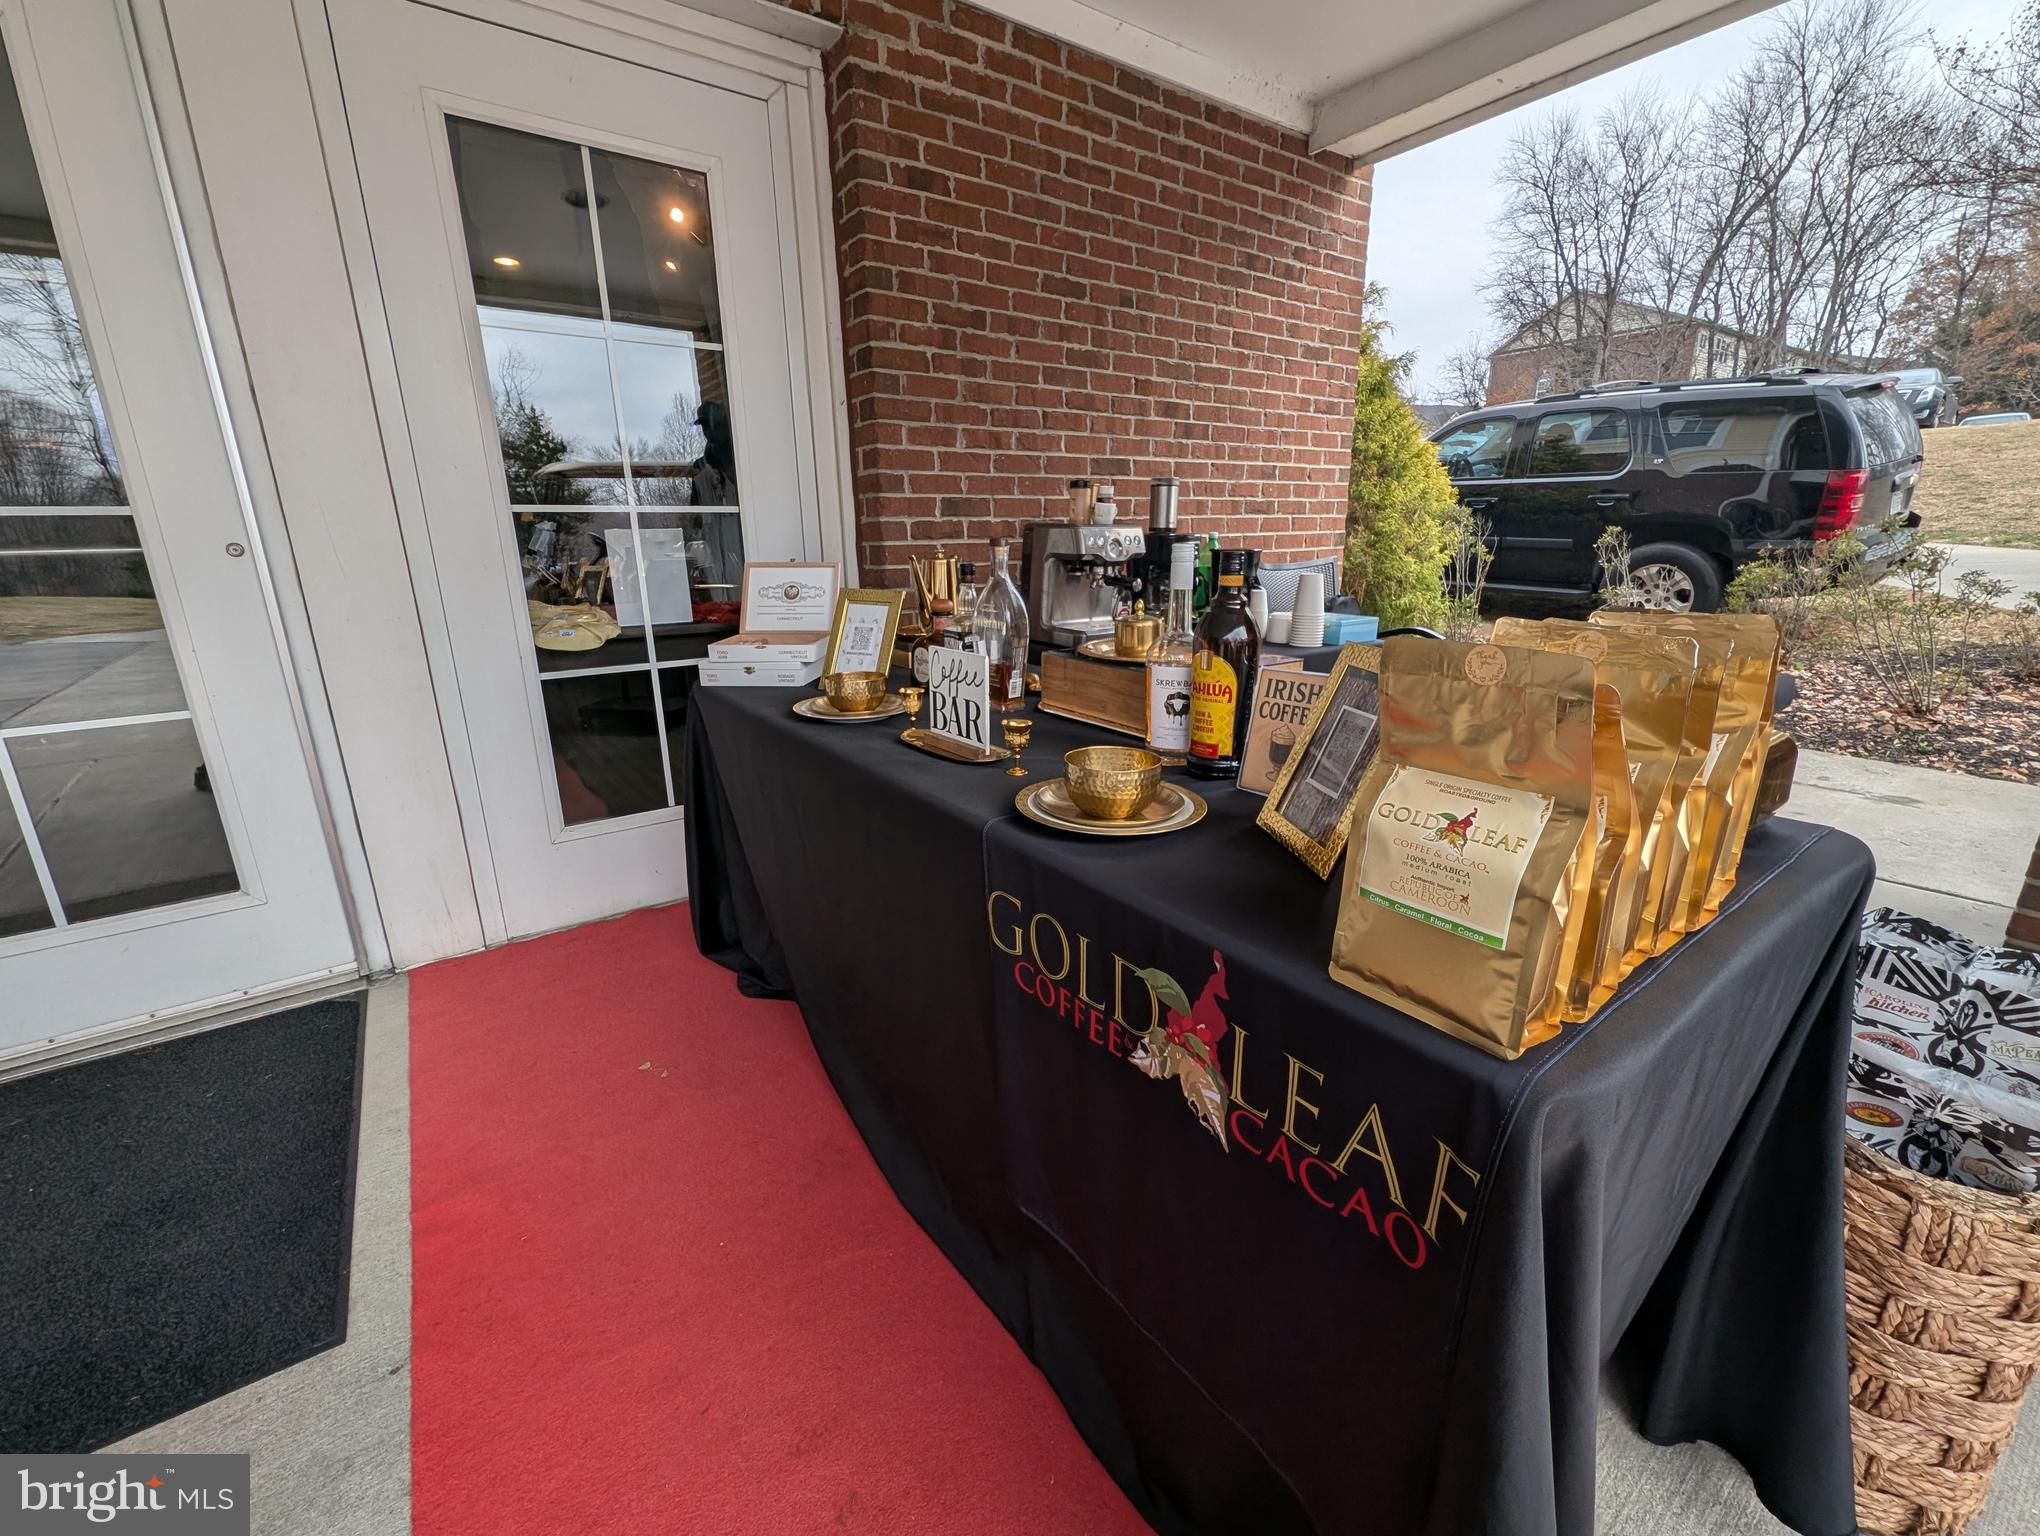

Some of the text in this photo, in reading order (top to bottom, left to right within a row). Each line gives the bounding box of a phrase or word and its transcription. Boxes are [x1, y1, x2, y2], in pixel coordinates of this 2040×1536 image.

[930, 649, 984, 698] Coffee
[1191, 680, 1233, 704] AHLÚA
[1263, 678, 1324, 705] IRISH
[930, 690, 985, 744] BAR
[1259, 700, 1311, 726] COFFE
[1463, 787, 1492, 798] SPECIALTY
[1491, 793, 1513, 803] COFFEE
[1377, 802, 1528, 854] GOLD LEAF
[1393, 837, 1487, 871] COFFEE & CACAO
[1406, 853, 1471, 879] 100% ARABICA
[1399, 875, 1458, 901] REPUBLIC OF
[1401, 860, 1472, 887] medium roast
[1389, 880, 1472, 916] CAMEROON
[1369, 894, 1484, 942] Citrus Caramel Floral Cocoa
[1869, 988, 1930, 1012] CAROLINA
[987, 890, 1481, 1248] GOLD LEAF
[1014, 961, 1122, 1058] COFFEE
[1229, 1109, 1428, 1270] CACAO
